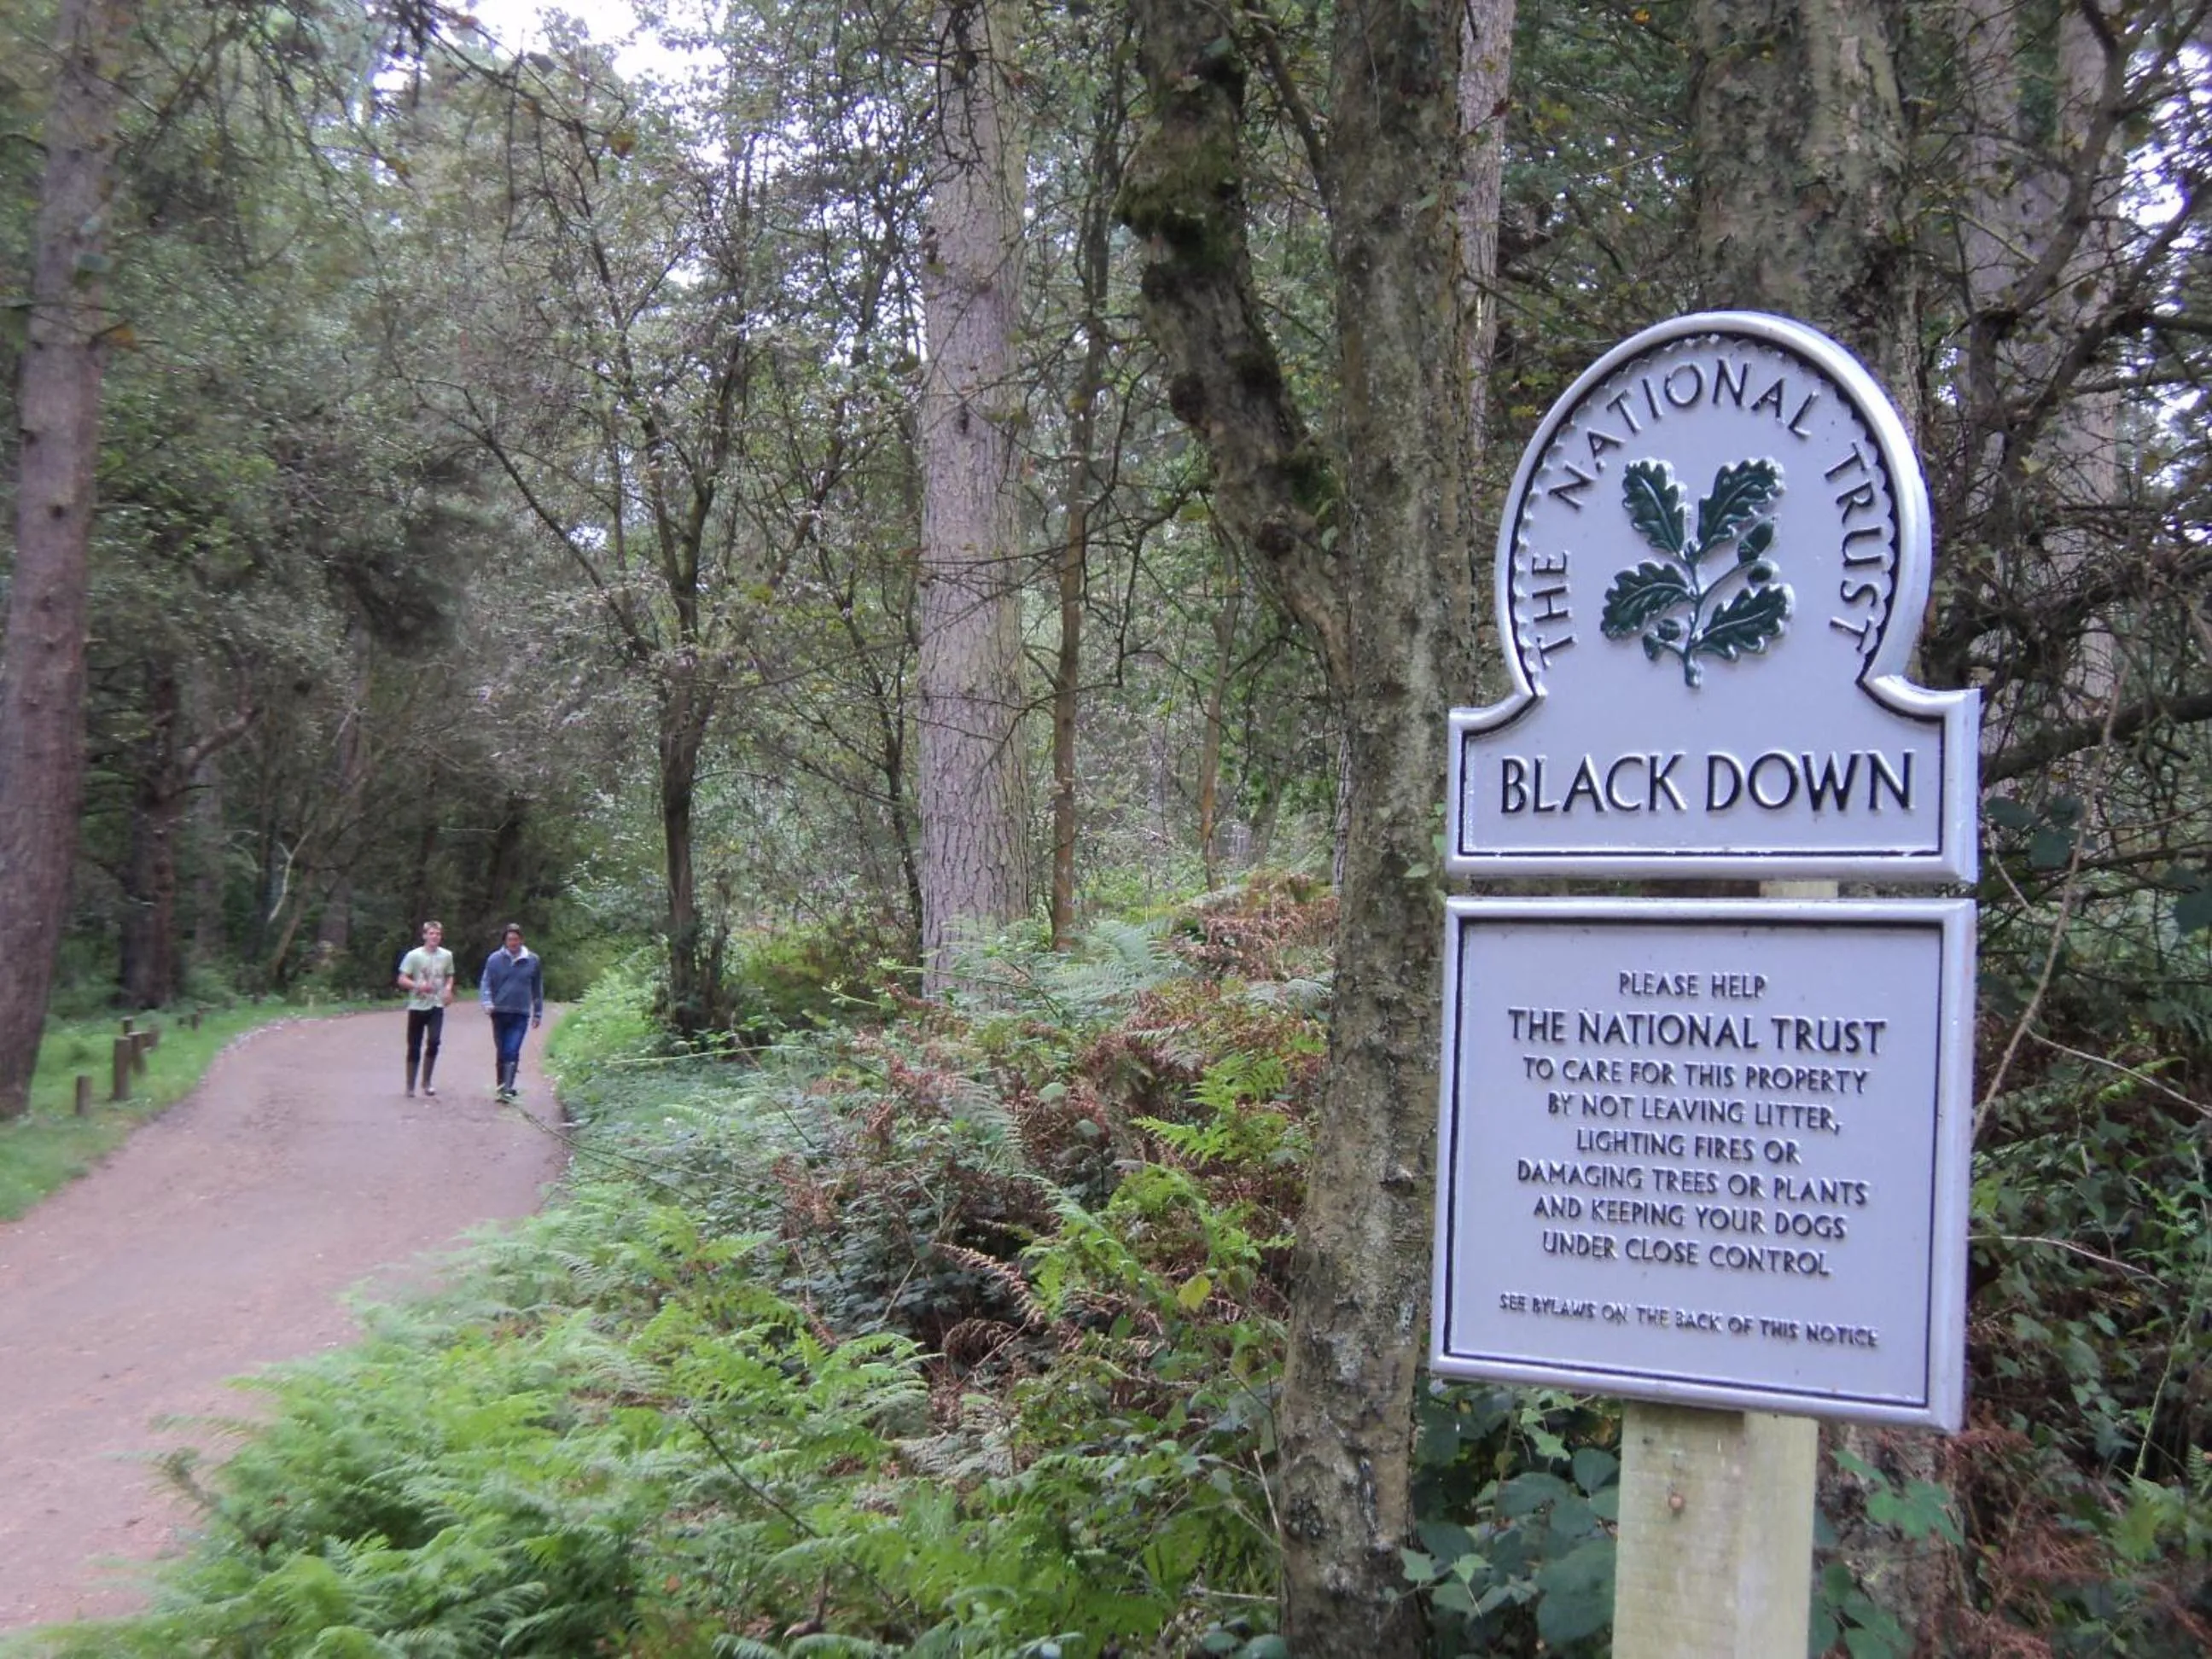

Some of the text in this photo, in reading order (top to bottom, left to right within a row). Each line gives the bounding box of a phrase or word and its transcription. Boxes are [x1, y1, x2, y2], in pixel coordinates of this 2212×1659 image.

[1532, 359, 1884, 668] THE NATIONAL TRUST
[1501, 750, 1917, 814] BLACK DOWN
[1619, 971, 1767, 998] PLEASE HELP
[1508, 1009, 1888, 1055] THE NATIONAL TRUST
[1523, 1057, 1869, 1094] TO CARE FOR THIS PROPERTY
[1548, 1092, 1842, 1134] BY NOT LEAVING LITTER,
[1577, 1128, 1802, 1164] LIGHTING FIRES OR
[1516, 1160, 1869, 1207] DAMAGING TREES OR PLANTS
[1534, 1196, 1846, 1240] AND KEEPING YOUR DOGS
[1543, 1231, 1831, 1277] UNDER CLOSE CONTROL
[1499, 1293, 1878, 1347] SEE BYLAWS ON THE BACK OF THIS NOTICE
